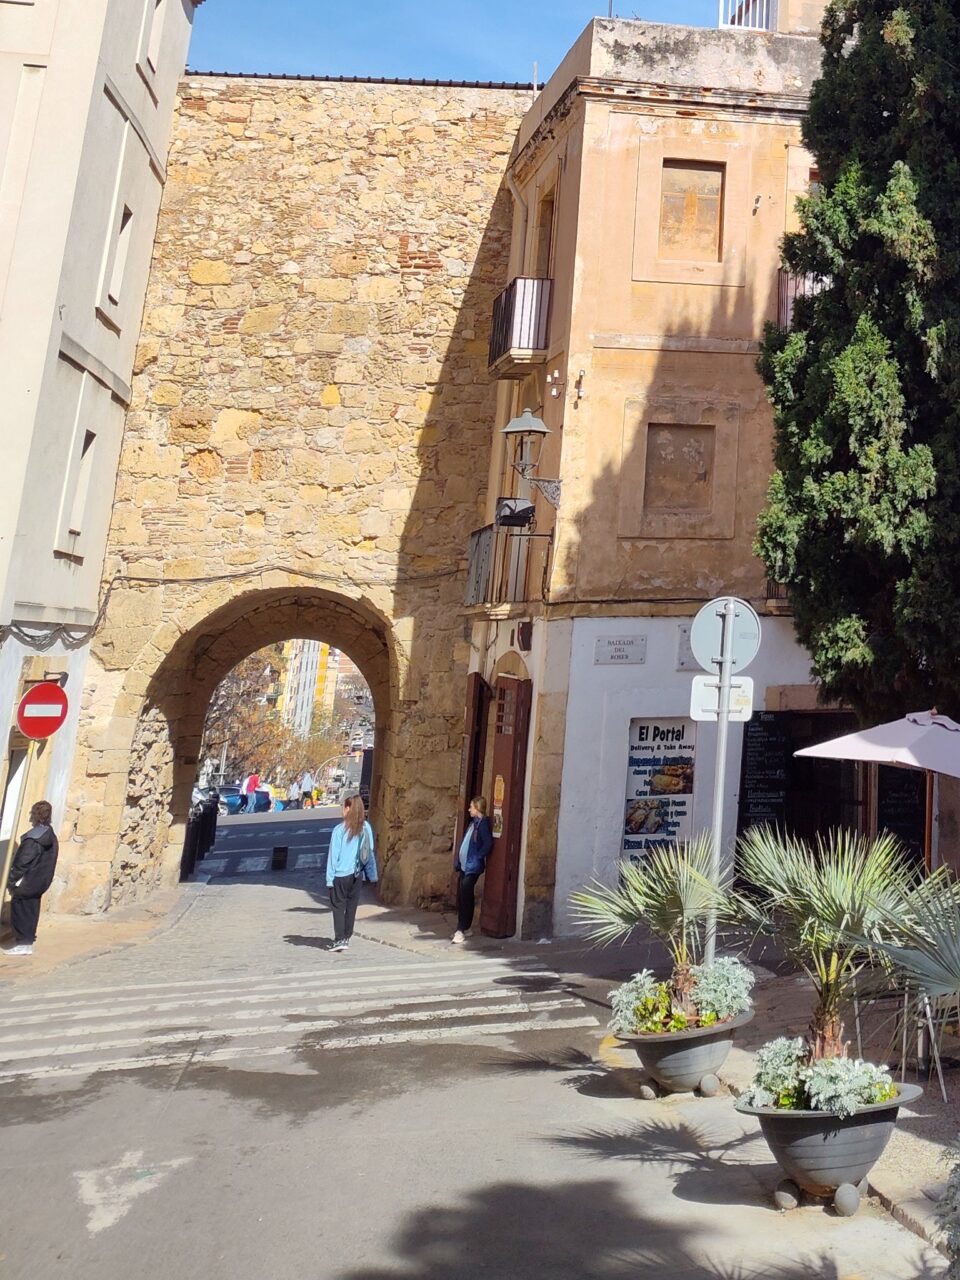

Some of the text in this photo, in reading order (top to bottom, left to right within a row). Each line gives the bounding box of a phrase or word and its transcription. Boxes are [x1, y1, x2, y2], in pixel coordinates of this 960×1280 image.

[638, 724, 685, 742] El Portal
[630, 744, 655, 752] Delivery
